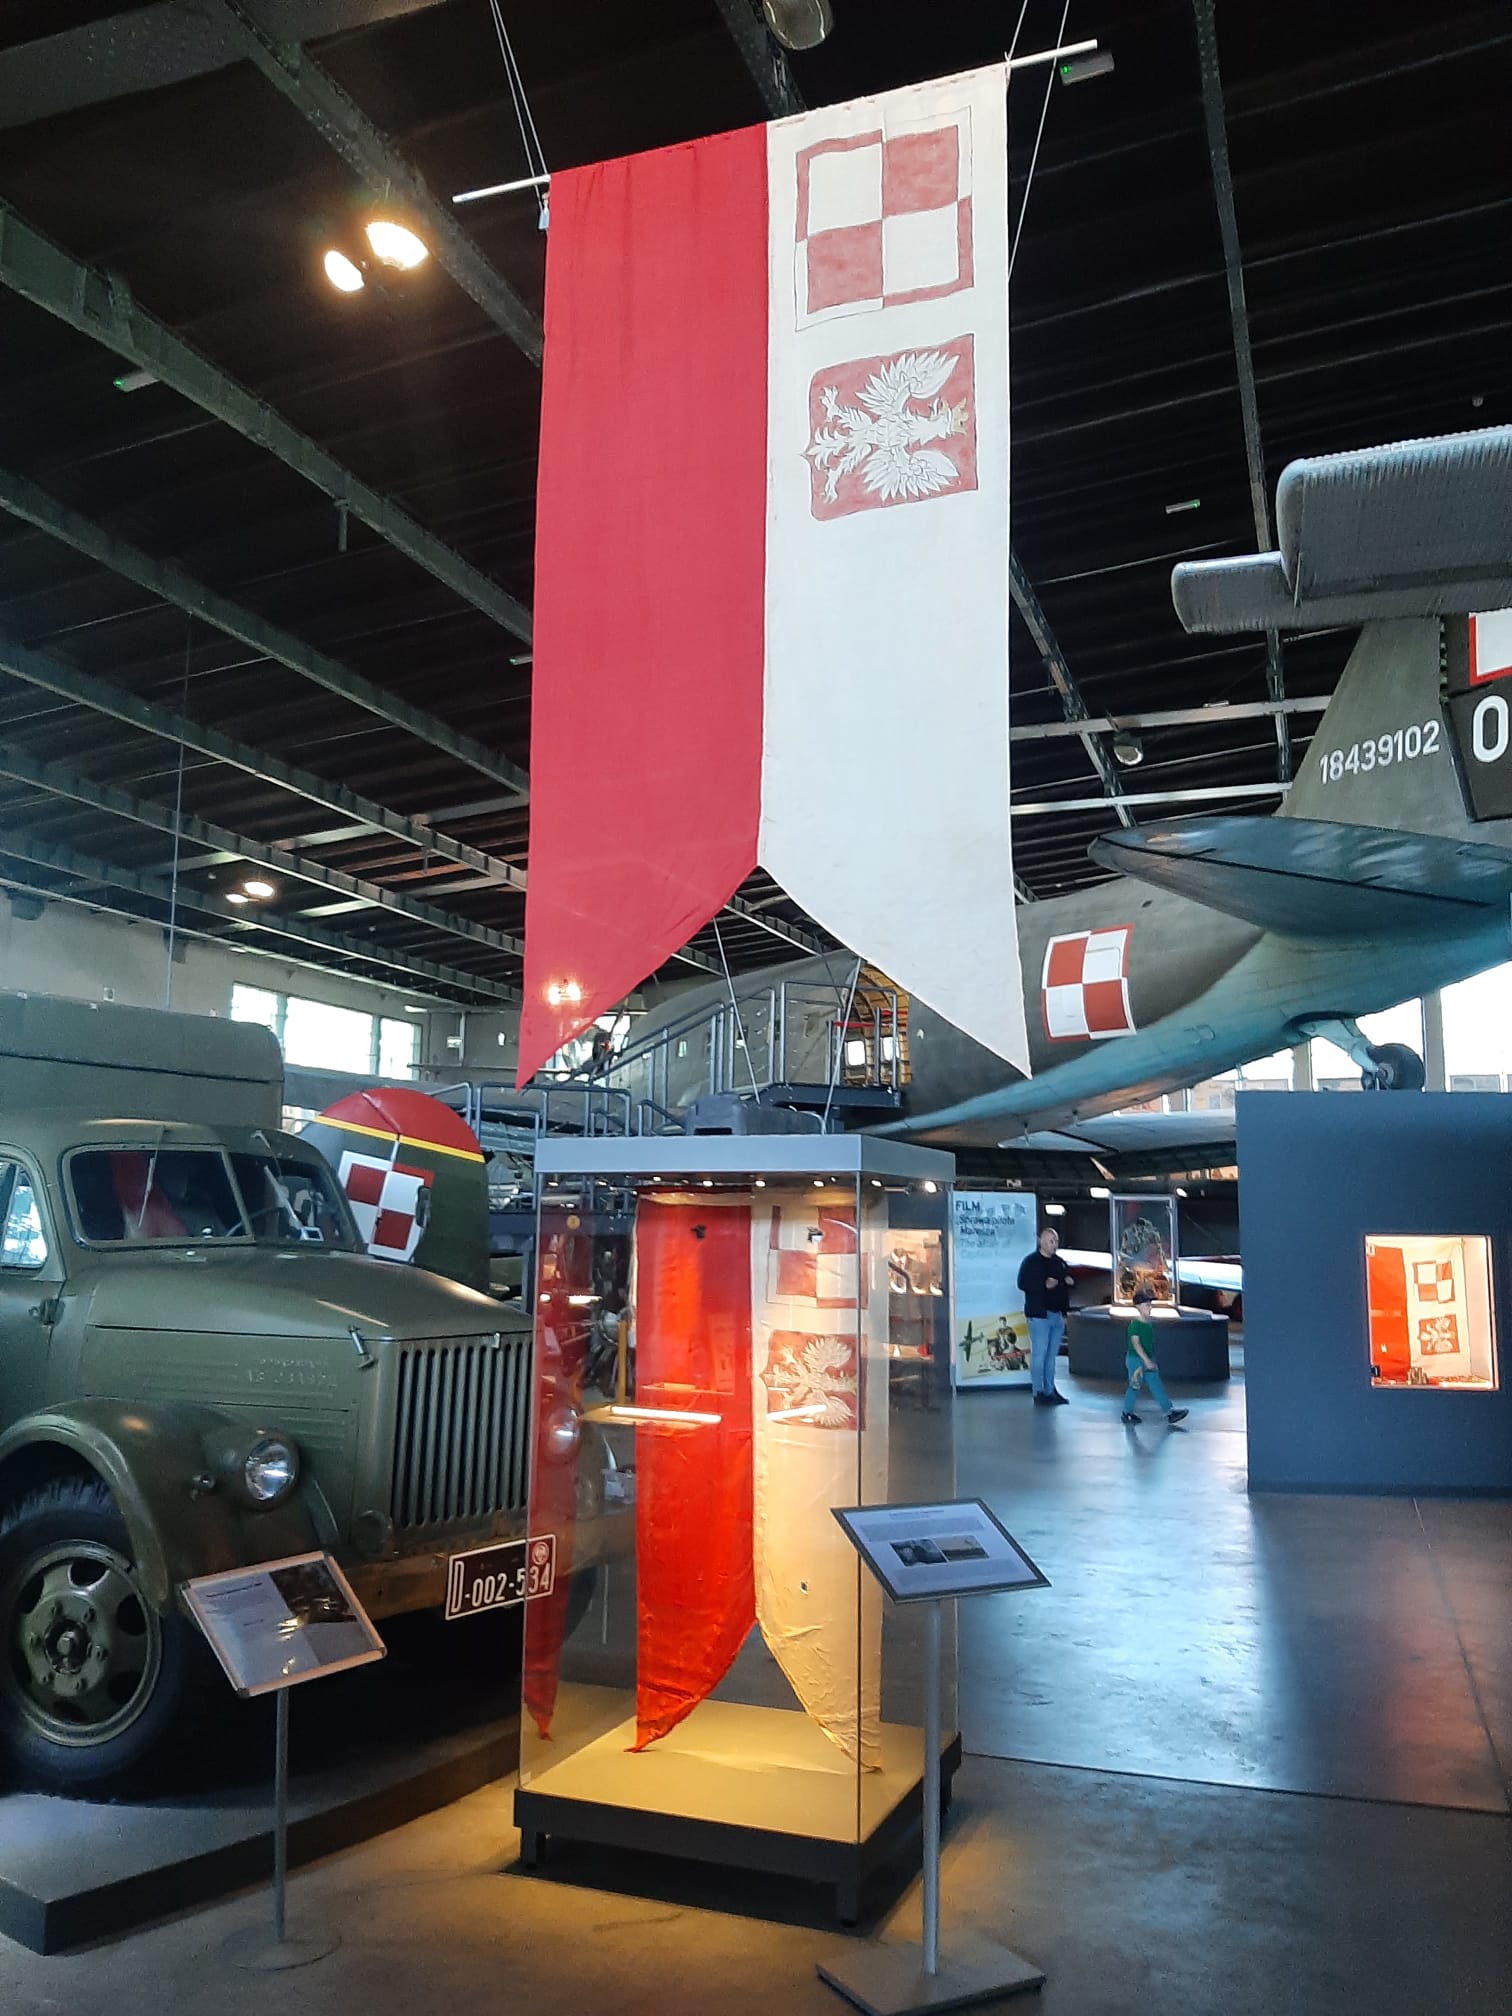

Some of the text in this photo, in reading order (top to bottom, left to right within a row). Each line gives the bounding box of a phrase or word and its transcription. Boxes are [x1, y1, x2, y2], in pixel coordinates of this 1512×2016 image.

[1319, 719, 1440, 785] 18439102
[1472, 695, 1509, 763] 0
[955, 1200, 981, 1212] FILM
